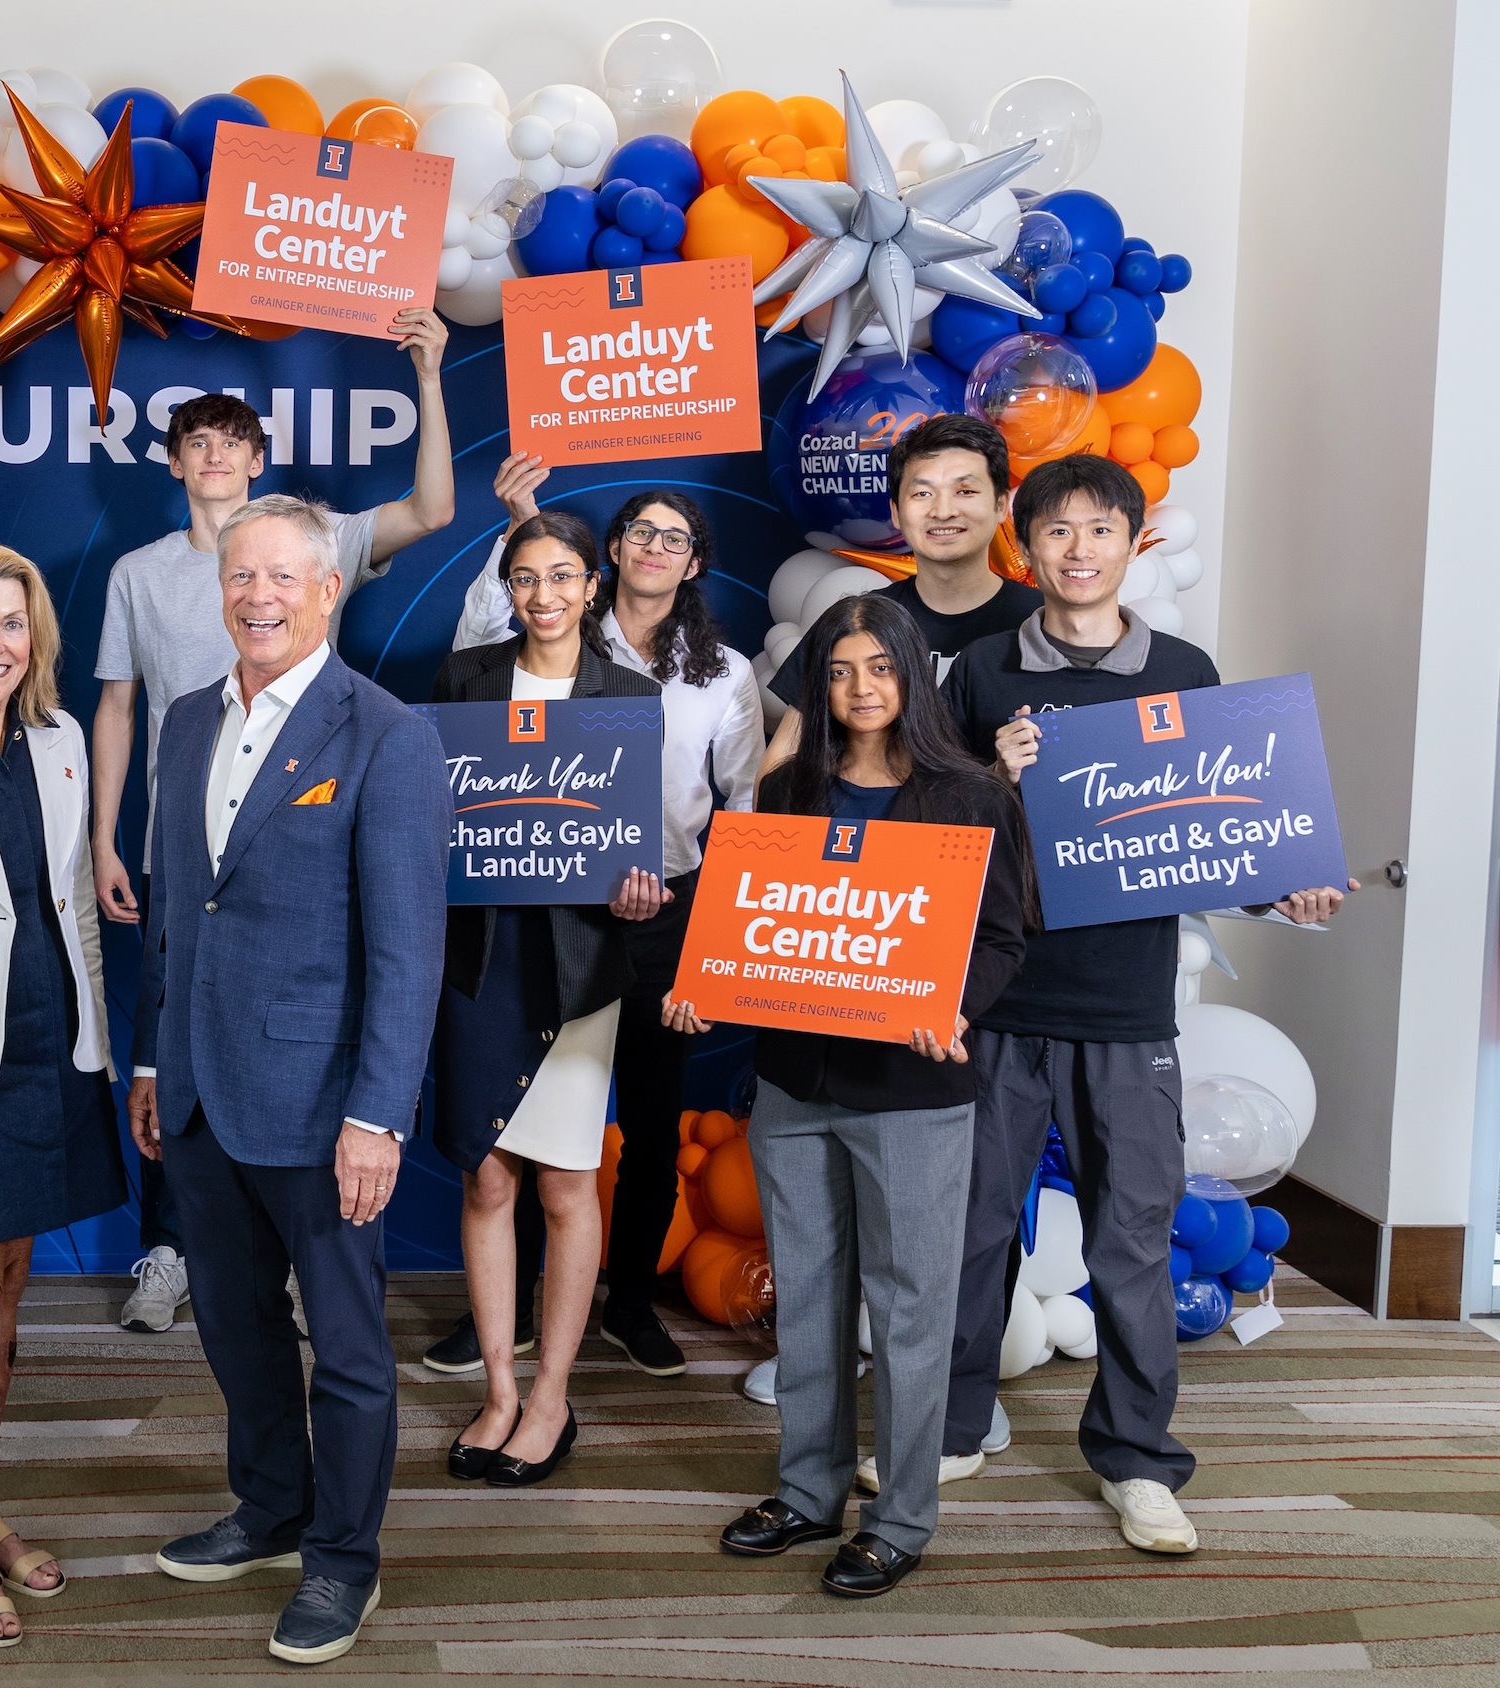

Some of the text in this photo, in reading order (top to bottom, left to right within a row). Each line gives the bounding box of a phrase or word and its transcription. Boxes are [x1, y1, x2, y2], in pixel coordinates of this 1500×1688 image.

[243, 181, 407, 243] Landuyt
[254, 224, 387, 275] Center
[218, 260, 415, 302] FOR ENTREPRENEURSHIP
[250, 294, 377, 323] GRAINGER ENGINEERING
[542, 316, 714, 365] Landuyt
[560, 362, 698, 403] Center
[530, 397, 737, 429] FOR ENTREPRENEURSHIP
[568, 431, 703, 451] GRAINGER ENGINEERING
[800, 430, 857, 452] Cozad
[801, 455, 840, 474] NEW
[445, 746, 623, 800] Thank You!
[1057, 732, 1276, 809] Thank You!
[529, 820, 553, 846] &
[558, 817, 642, 852] Gayle
[1054, 808, 1314, 868] Richard & Gayle
[465, 850, 587, 884] Landuyt
[1118, 850, 1259, 892] Landuyt
[734, 871, 930, 932] Landuyt
[743, 915, 901, 967] Center
[700, 957, 936, 998] FOR ENTREPRENEURSHIP
[734, 995, 887, 1024] GRAINGER ENGINEERING
